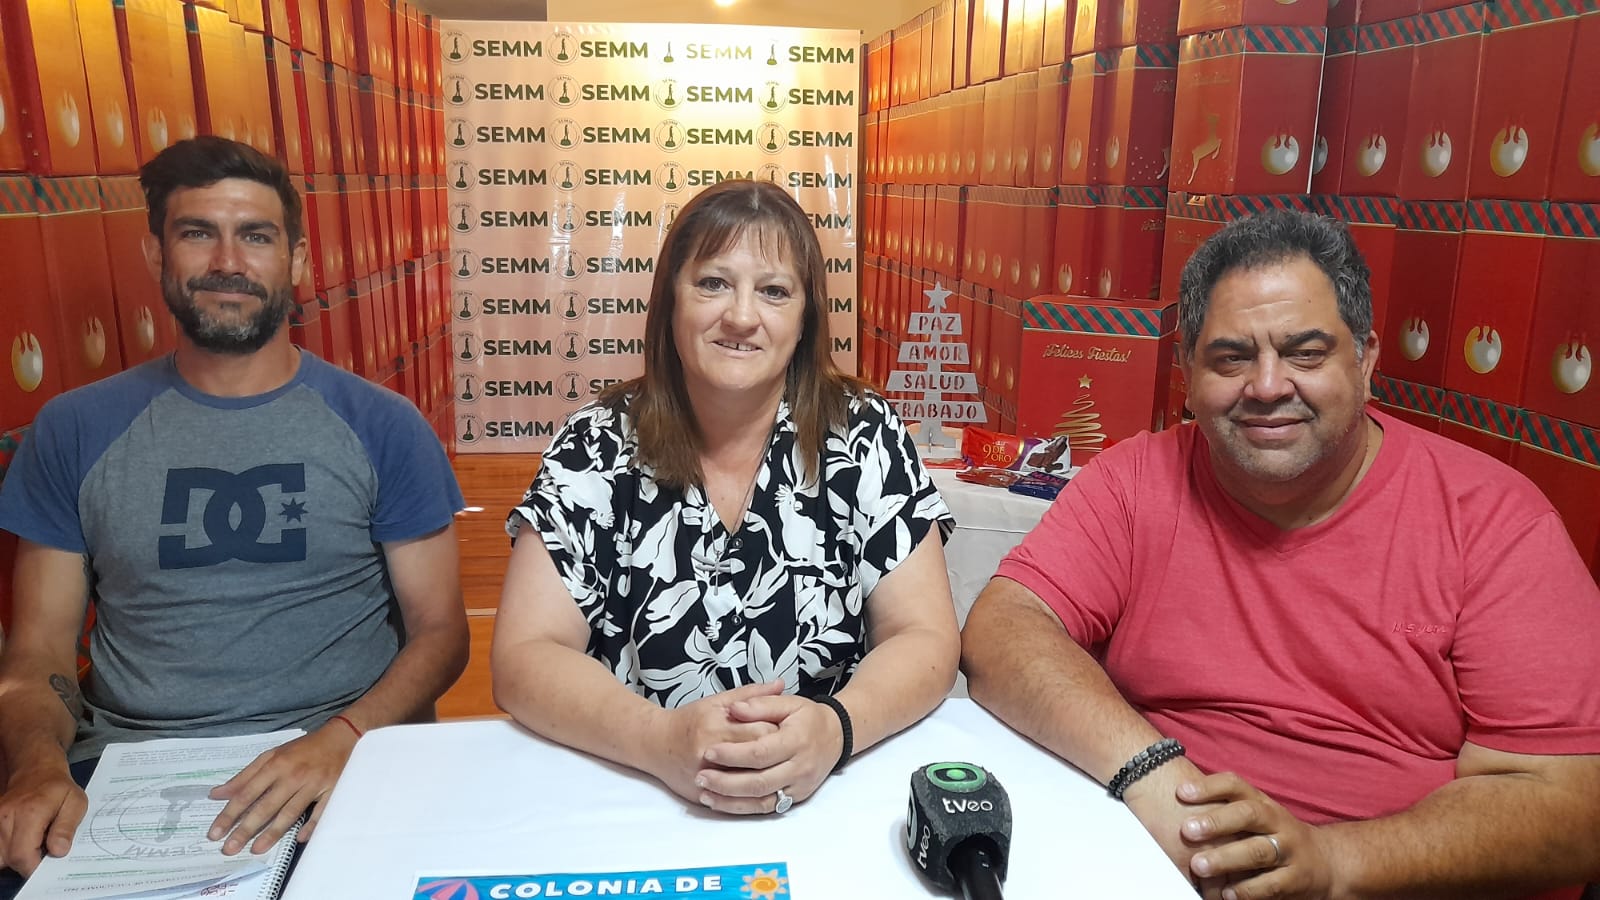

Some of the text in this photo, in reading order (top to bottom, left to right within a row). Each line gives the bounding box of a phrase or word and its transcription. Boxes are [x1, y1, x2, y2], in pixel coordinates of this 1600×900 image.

[472, 40, 854, 64] SEMM SEMM SEMM SEMM
[474, 83, 854, 106] SEMM SEMM SEMM SEMM
[476, 126, 853, 147] SEMM SEMM SEMM SEMM
[478, 169, 547, 186] SEMM
[584, 169, 651, 186] SEMM
[788, 172, 852, 188] SEMM
[480, 211, 548, 227] SEMM
[585, 210, 652, 227] SEMM
[481, 257, 549, 273] SEMM
[586, 257, 653, 273] SEMM
[482, 298, 650, 315] SEMM SEMM
[919, 316, 956, 332] PAZ
[483, 340, 552, 356] SEMM
[908, 344, 962, 361] AMOR
[1087, 346, 1131, 362] Fiestas!
[484, 381, 553, 397] SEMM
[903, 373, 965, 390] SALUD
[890, 402, 977, 419] TRABAJO
[485, 421, 554, 438] SEMM
[982, 443, 1005, 457] 9 DE
[991, 454, 1012, 463] ORO
[942, 797, 993, 814] tveo
[489, 875, 722, 900] COLONIA DE
